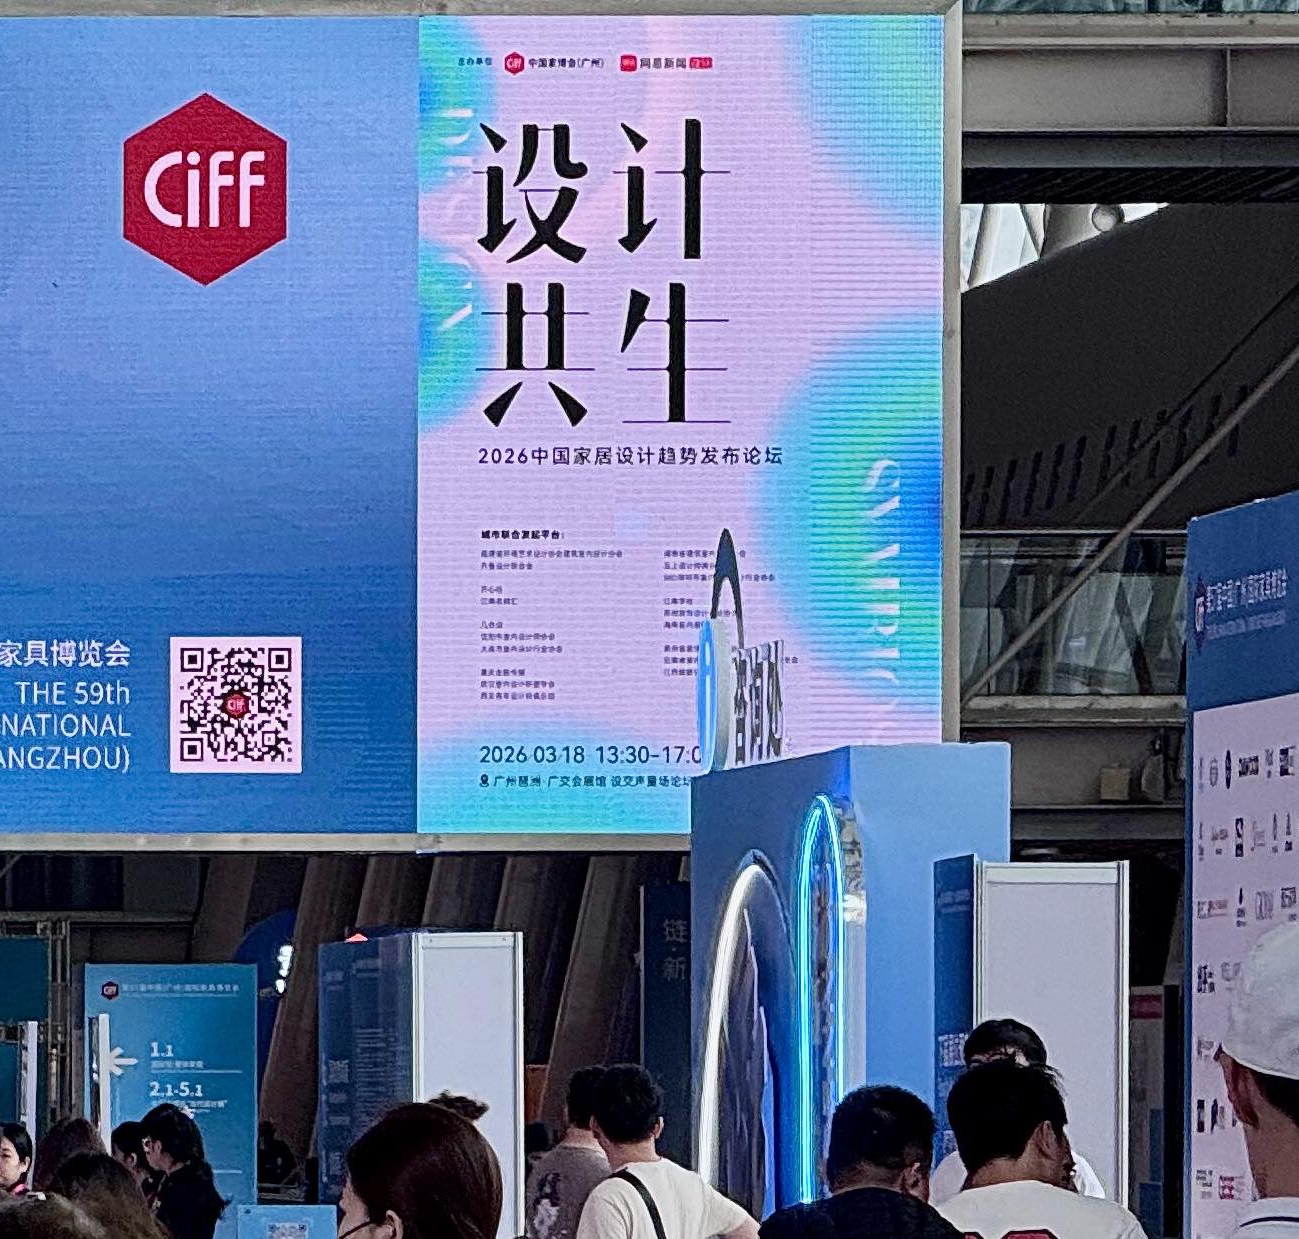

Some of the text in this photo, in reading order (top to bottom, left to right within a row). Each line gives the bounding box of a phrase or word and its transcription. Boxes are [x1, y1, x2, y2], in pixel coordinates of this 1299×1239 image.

[472, 117, 732, 264] 设计
[475, 282, 732, 427] 共生
[478, 446, 783, 467] 2026中国家居设计趋势发布论坛
[14, 680, 131, 706] THE 59th
[149, 1041, 174, 1058] 1.1
[149, 1080, 204, 1098] 2.1-5.1
